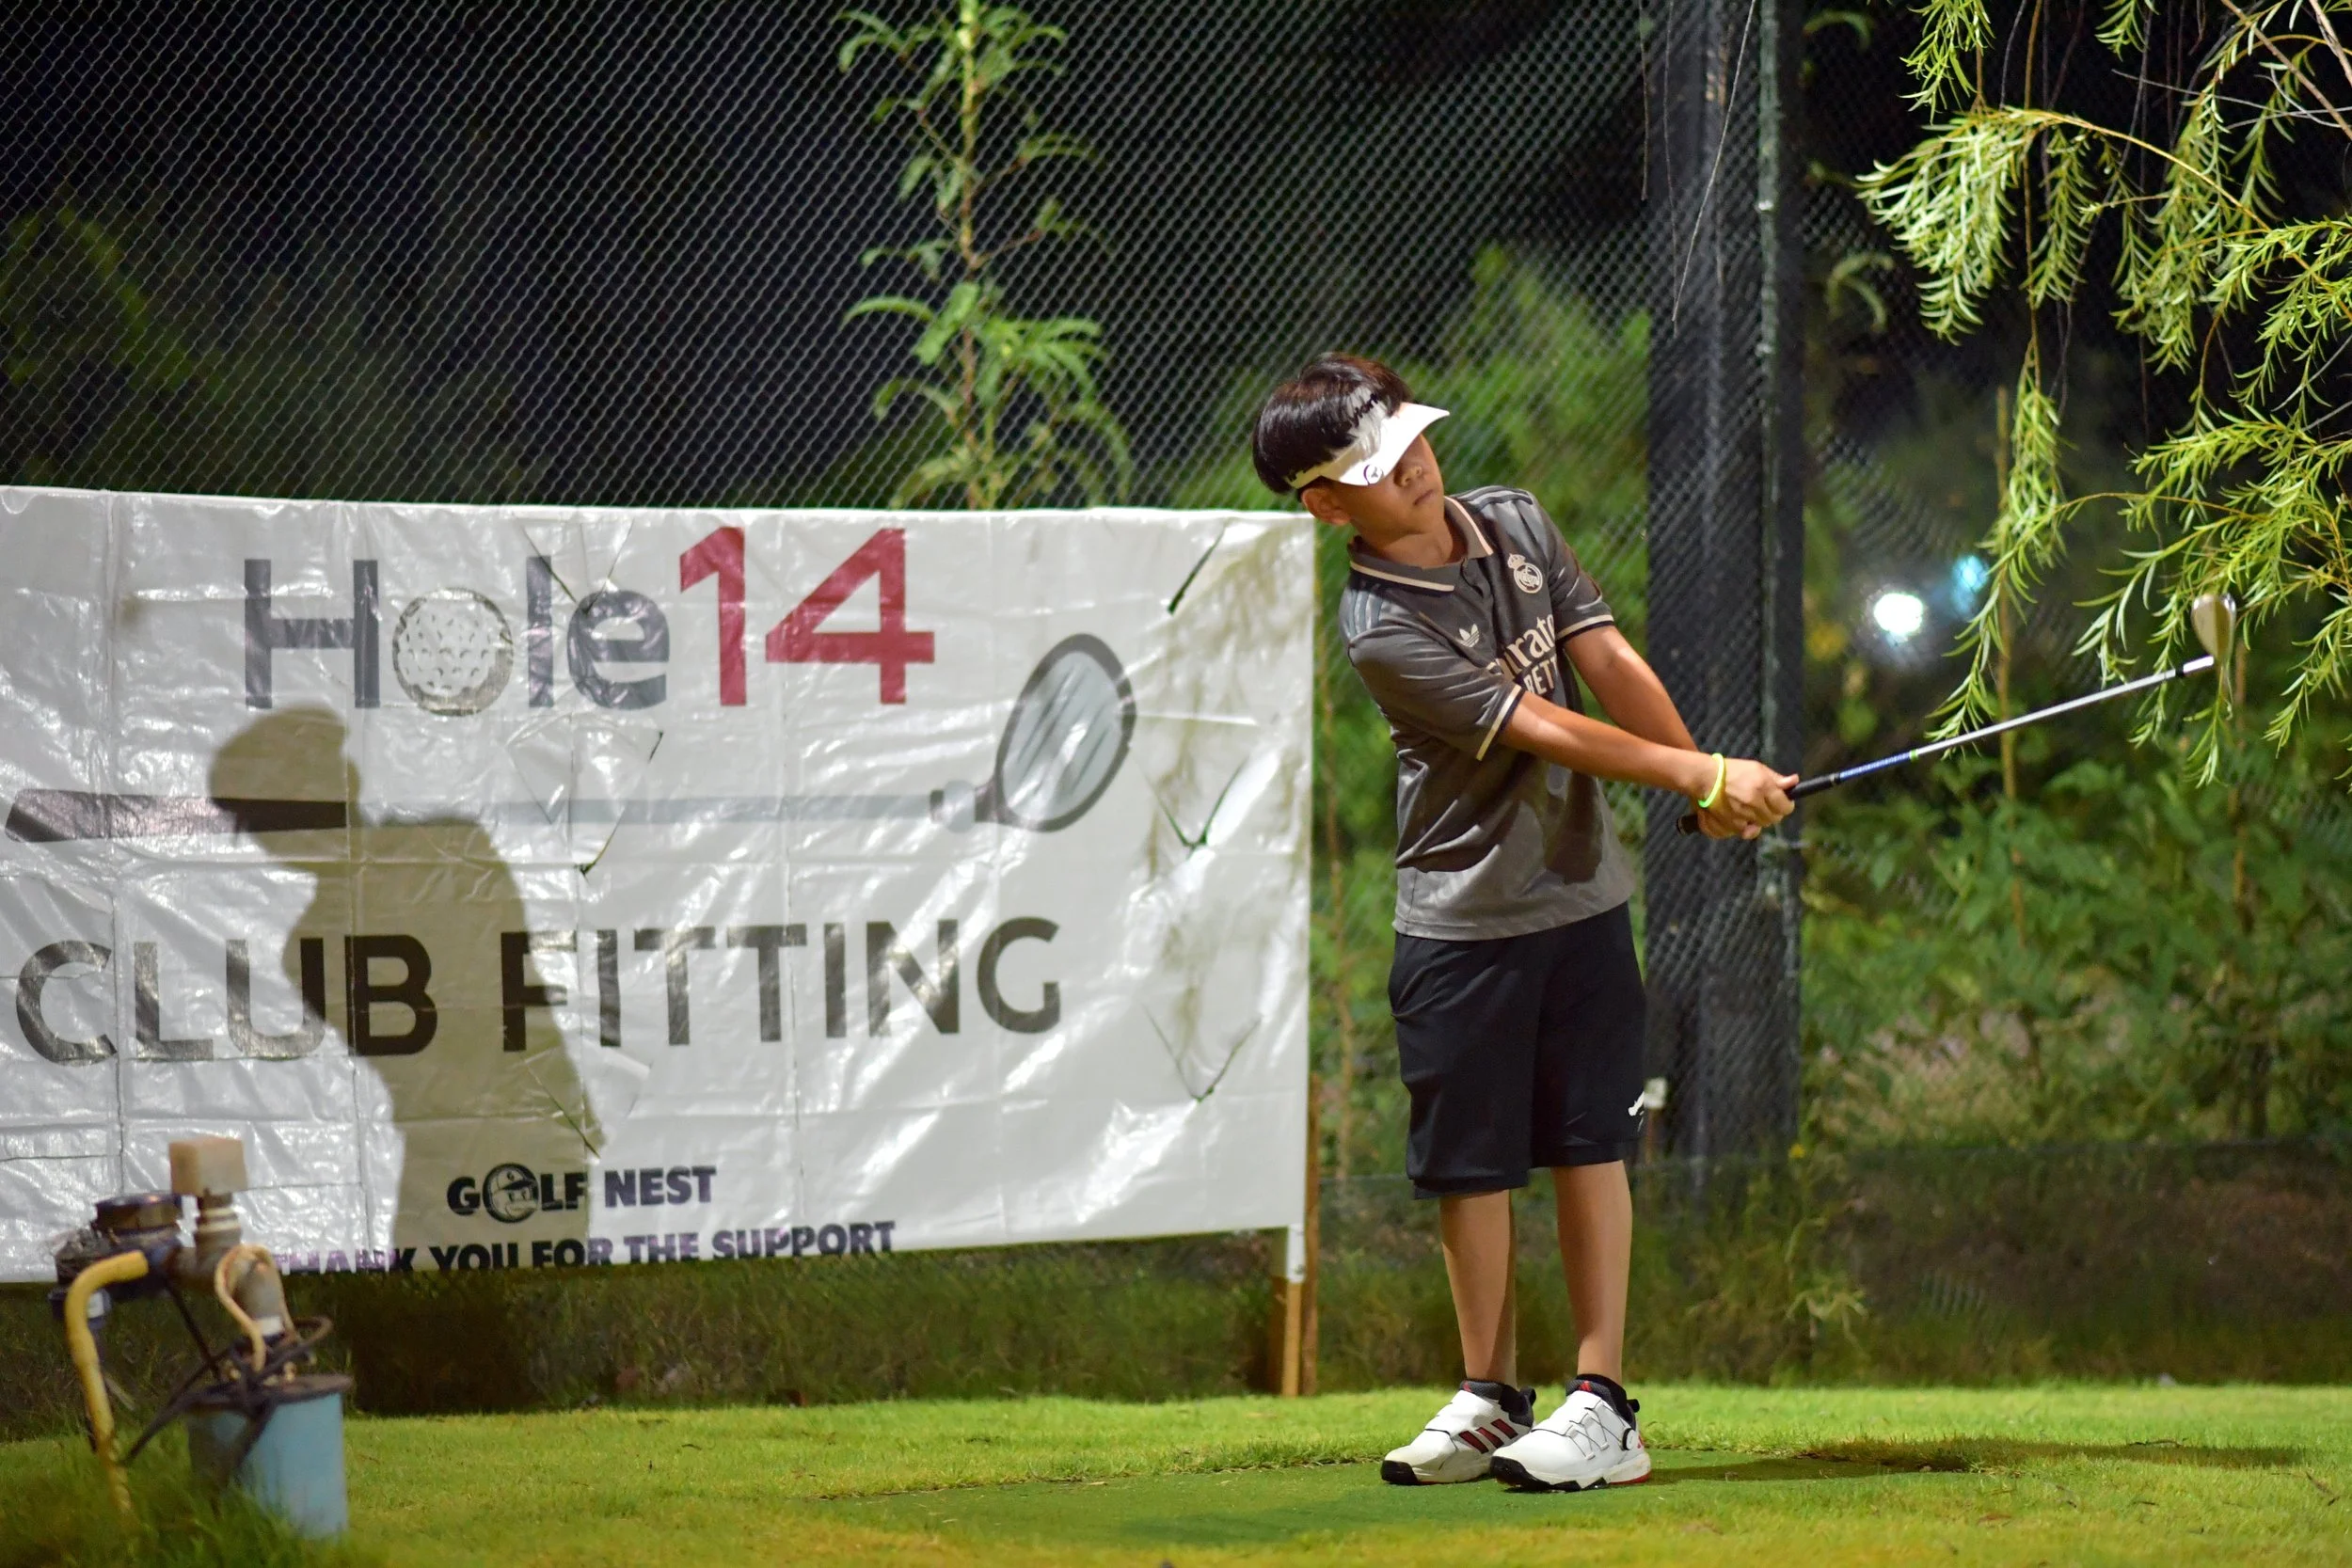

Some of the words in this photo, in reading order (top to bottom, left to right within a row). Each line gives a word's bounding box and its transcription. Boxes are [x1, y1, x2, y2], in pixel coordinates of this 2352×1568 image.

[16, 934, 437, 1064] CLUB
[501, 917, 1061, 1052] FITTING
[447, 1163, 587, 1223] GOLF
[605, 1165, 716, 1208] NEST
[428, 1243, 518, 1271] YOU
[532, 1238, 612, 1268] FOR
[625, 1232, 699, 1263] THE
[712, 1221, 896, 1259] SUPPORT
